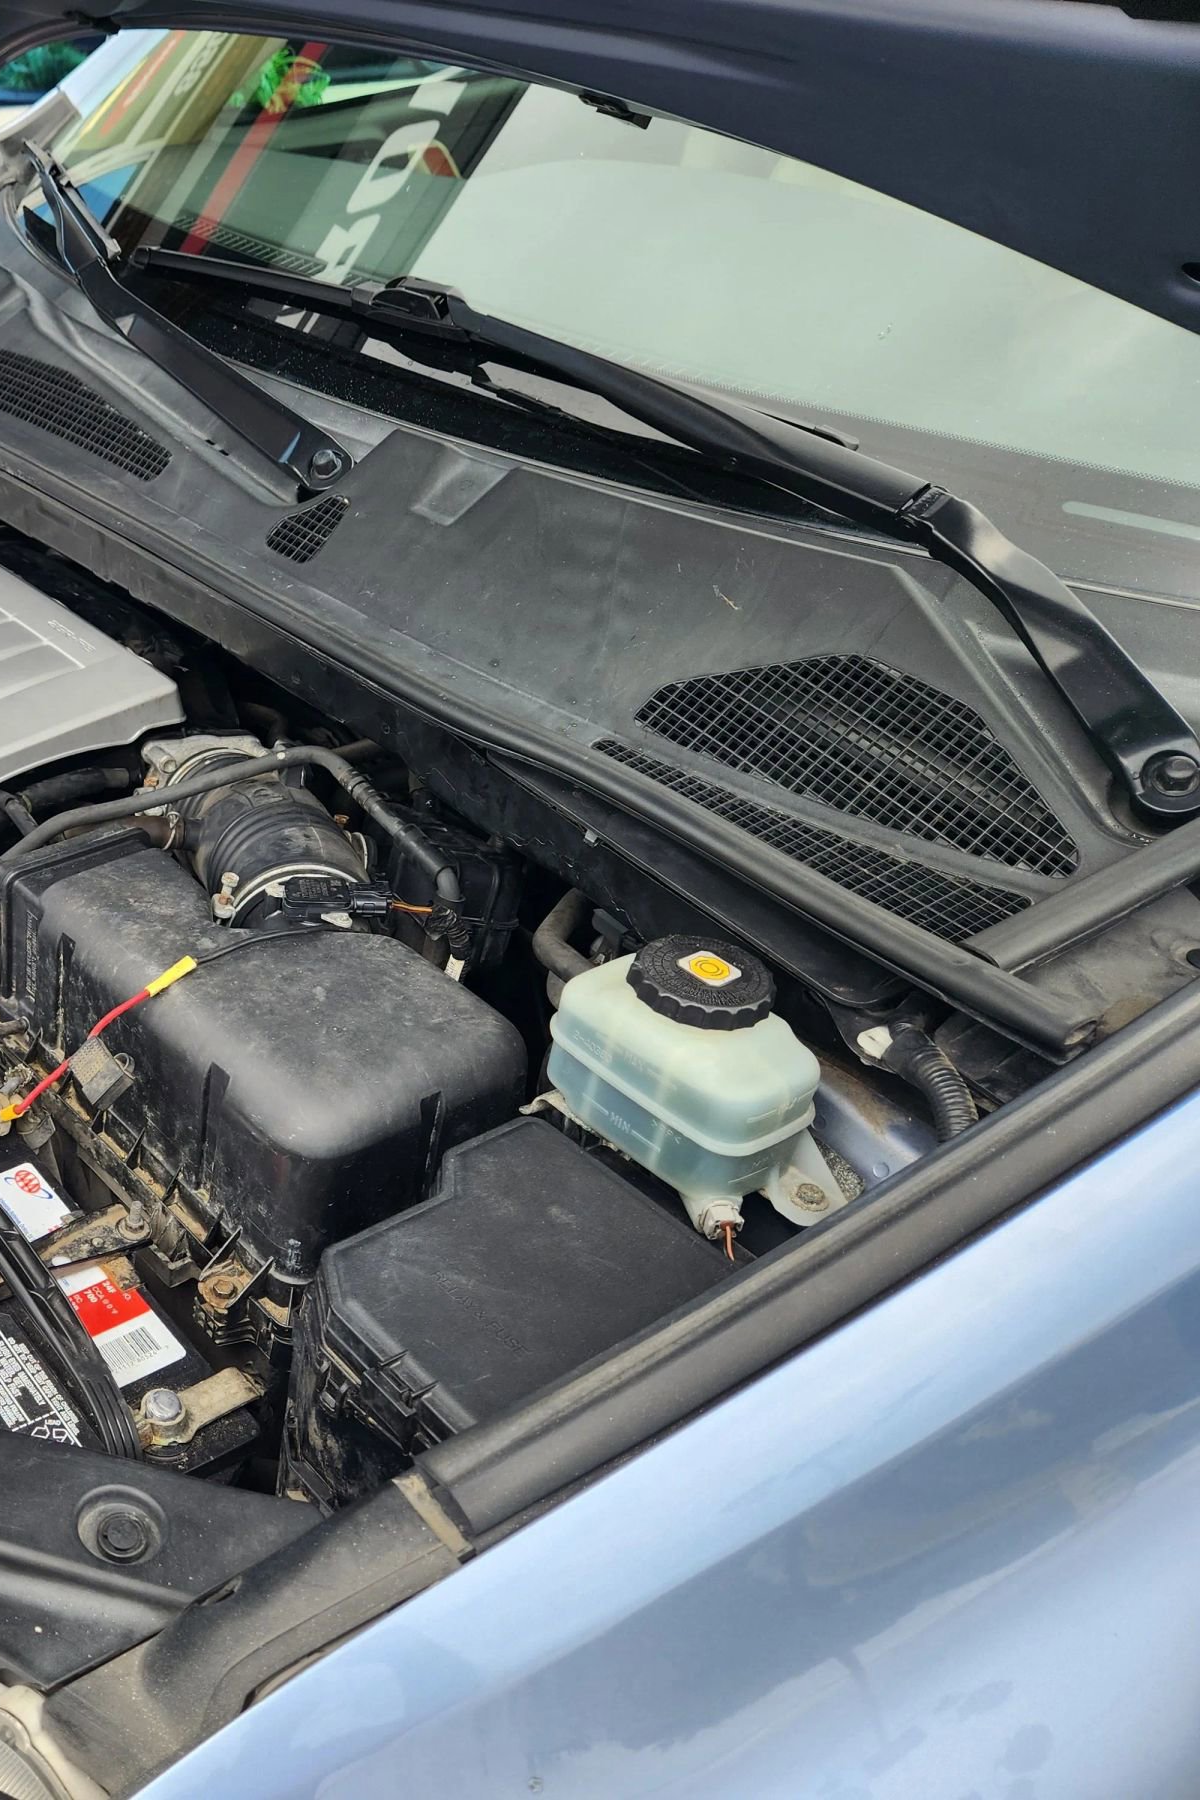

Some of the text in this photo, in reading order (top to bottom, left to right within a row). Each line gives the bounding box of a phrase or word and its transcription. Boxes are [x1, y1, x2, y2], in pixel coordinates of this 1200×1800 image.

[609, 1112, 631, 1134] MIN
[92, 1286, 103, 1300] CCA
[102, 1280, 116, 1294] 24F
[84, 1289, 98, 1303] 700
[430, 1271, 480, 1312] RELAY
[484, 1320, 533, 1359] FUSE
[7, 1382, 22, 1397] FAST
[16, 1370, 46, 1406] IMMEDIATELY
